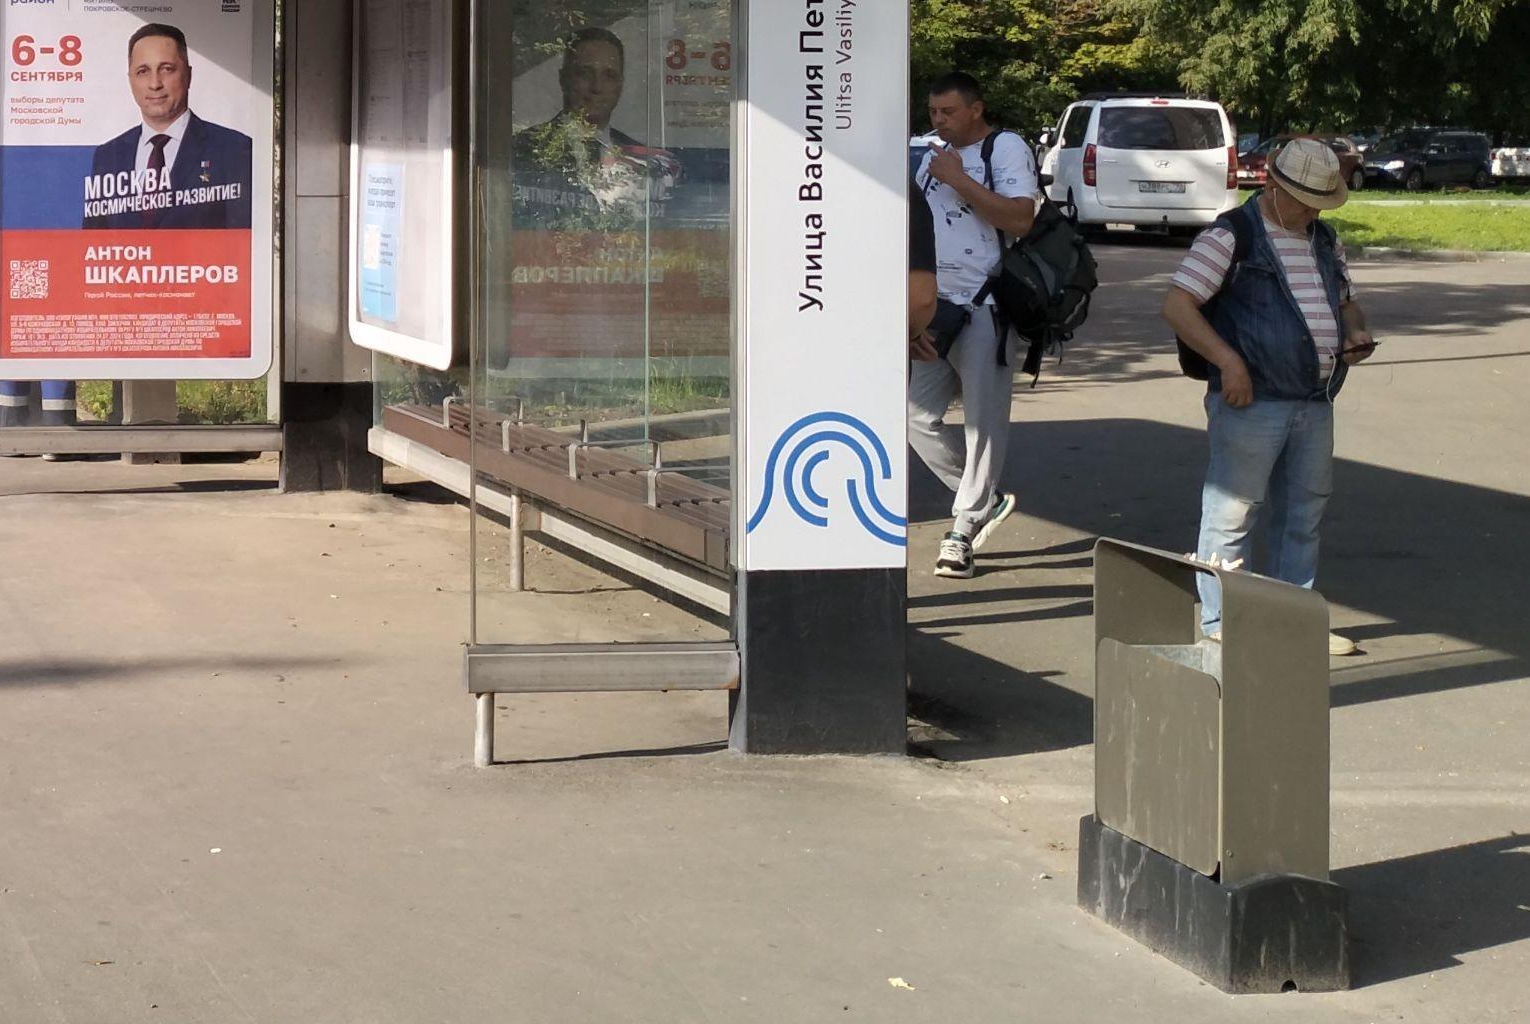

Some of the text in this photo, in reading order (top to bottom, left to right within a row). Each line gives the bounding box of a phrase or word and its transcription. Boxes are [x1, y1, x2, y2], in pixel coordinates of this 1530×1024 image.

[11, 34, 83, 67] 6-8
[10, 71, 83, 82] СЕНТЯБРЯ
[10, 96, 85, 105] выборы депутата
[10, 106, 64, 114] Московской
[834, 72, 852, 130] Ulitsa
[10, 116, 82, 126] городской Думы
[798, 64, 824, 202] Василия
[84, 165, 172, 201] МОСКВА
[84, 182, 241, 218] КОСМИЧЕСКОЕ РАЗВИТИЕ!
[84, 245, 152, 261] АНТОН
[798, 213, 827, 312] Улица
[84, 264, 239, 284] ШКАПЛЕРОВ
